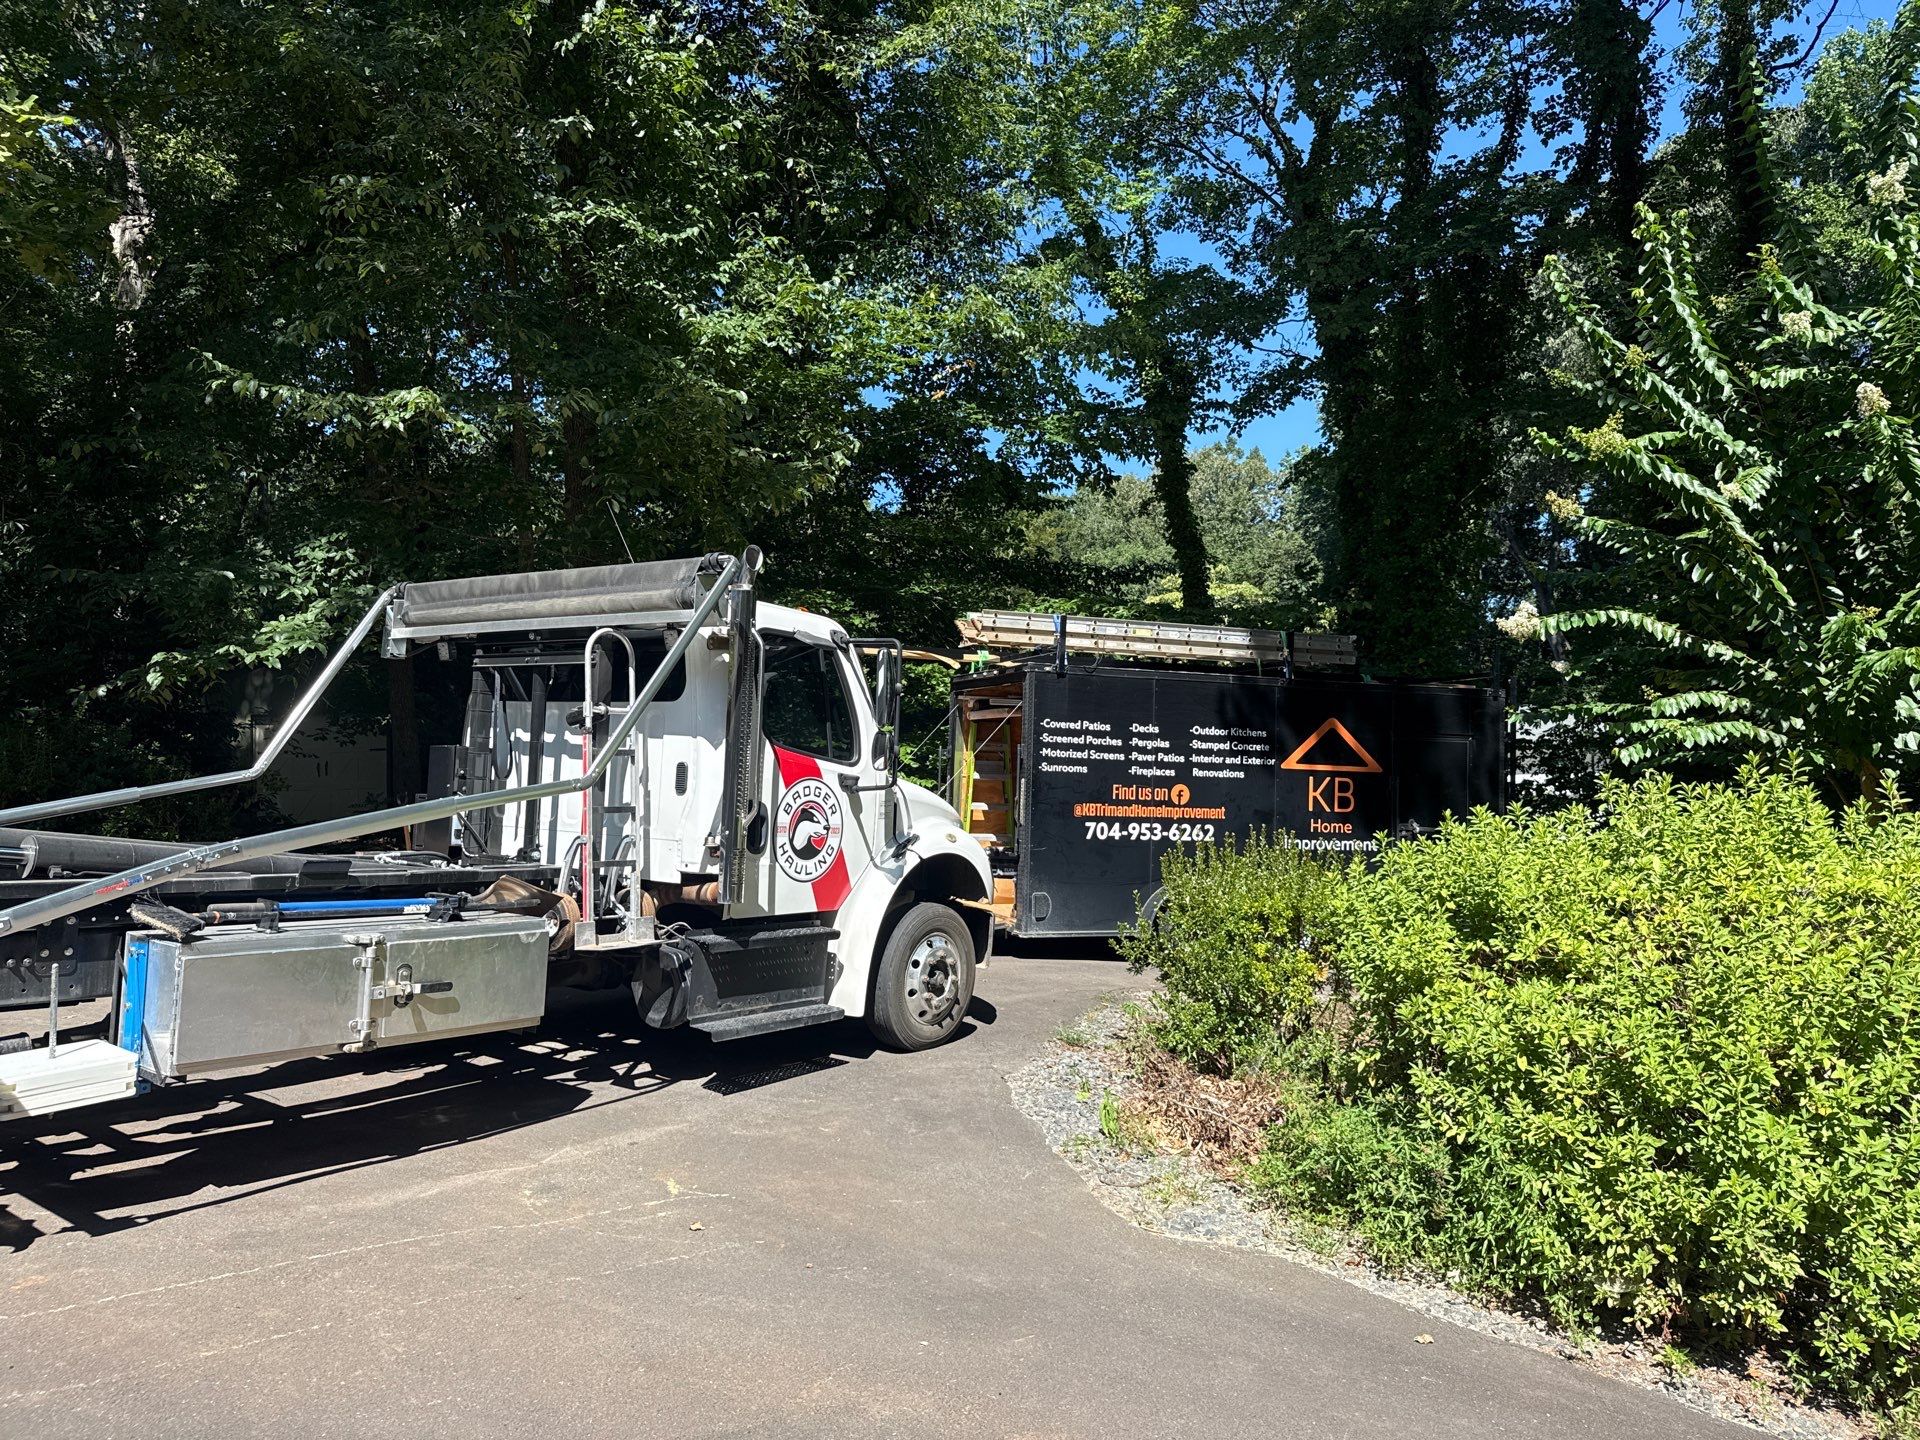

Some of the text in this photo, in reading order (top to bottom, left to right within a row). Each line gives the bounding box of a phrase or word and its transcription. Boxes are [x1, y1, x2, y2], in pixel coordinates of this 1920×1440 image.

[1040, 719, 1110, 731] -Covered Patios
[1129, 724, 1159, 733] -Decks
[1190, 727, 1267, 737] -Outdoor Kitchens
[1040, 734, 1122, 746] -Screened Porches
[1129, 738, 1169, 749] -Pergolas
[1190, 741, 1270, 751] -Stamped Concrete
[1040, 748, 1125, 760] -Motorized Screens
[1129, 752, 1185, 763] -Paver Patios
[1189, 755, 1276, 765] -Interior and Exterior
[1039, 763, 1087, 773] -Sunrooms
[1128, 767, 1175, 777] -Fireplaces
[1193, 768, 1244, 778] Renovations
[1113, 785, 1136, 800] Find
[1139, 787, 1152, 800] us
[1154, 787, 1168, 800] on
[1308, 776, 1355, 813] KB
[783, 785, 837, 816] BADGER
[1074, 803, 1225, 820] @KBTrimandHomeImprovement
[1085, 822, 1214, 842] 704-953-6262
[1310, 819, 1352, 834] Home
[779, 843, 835, 876] HAULING
